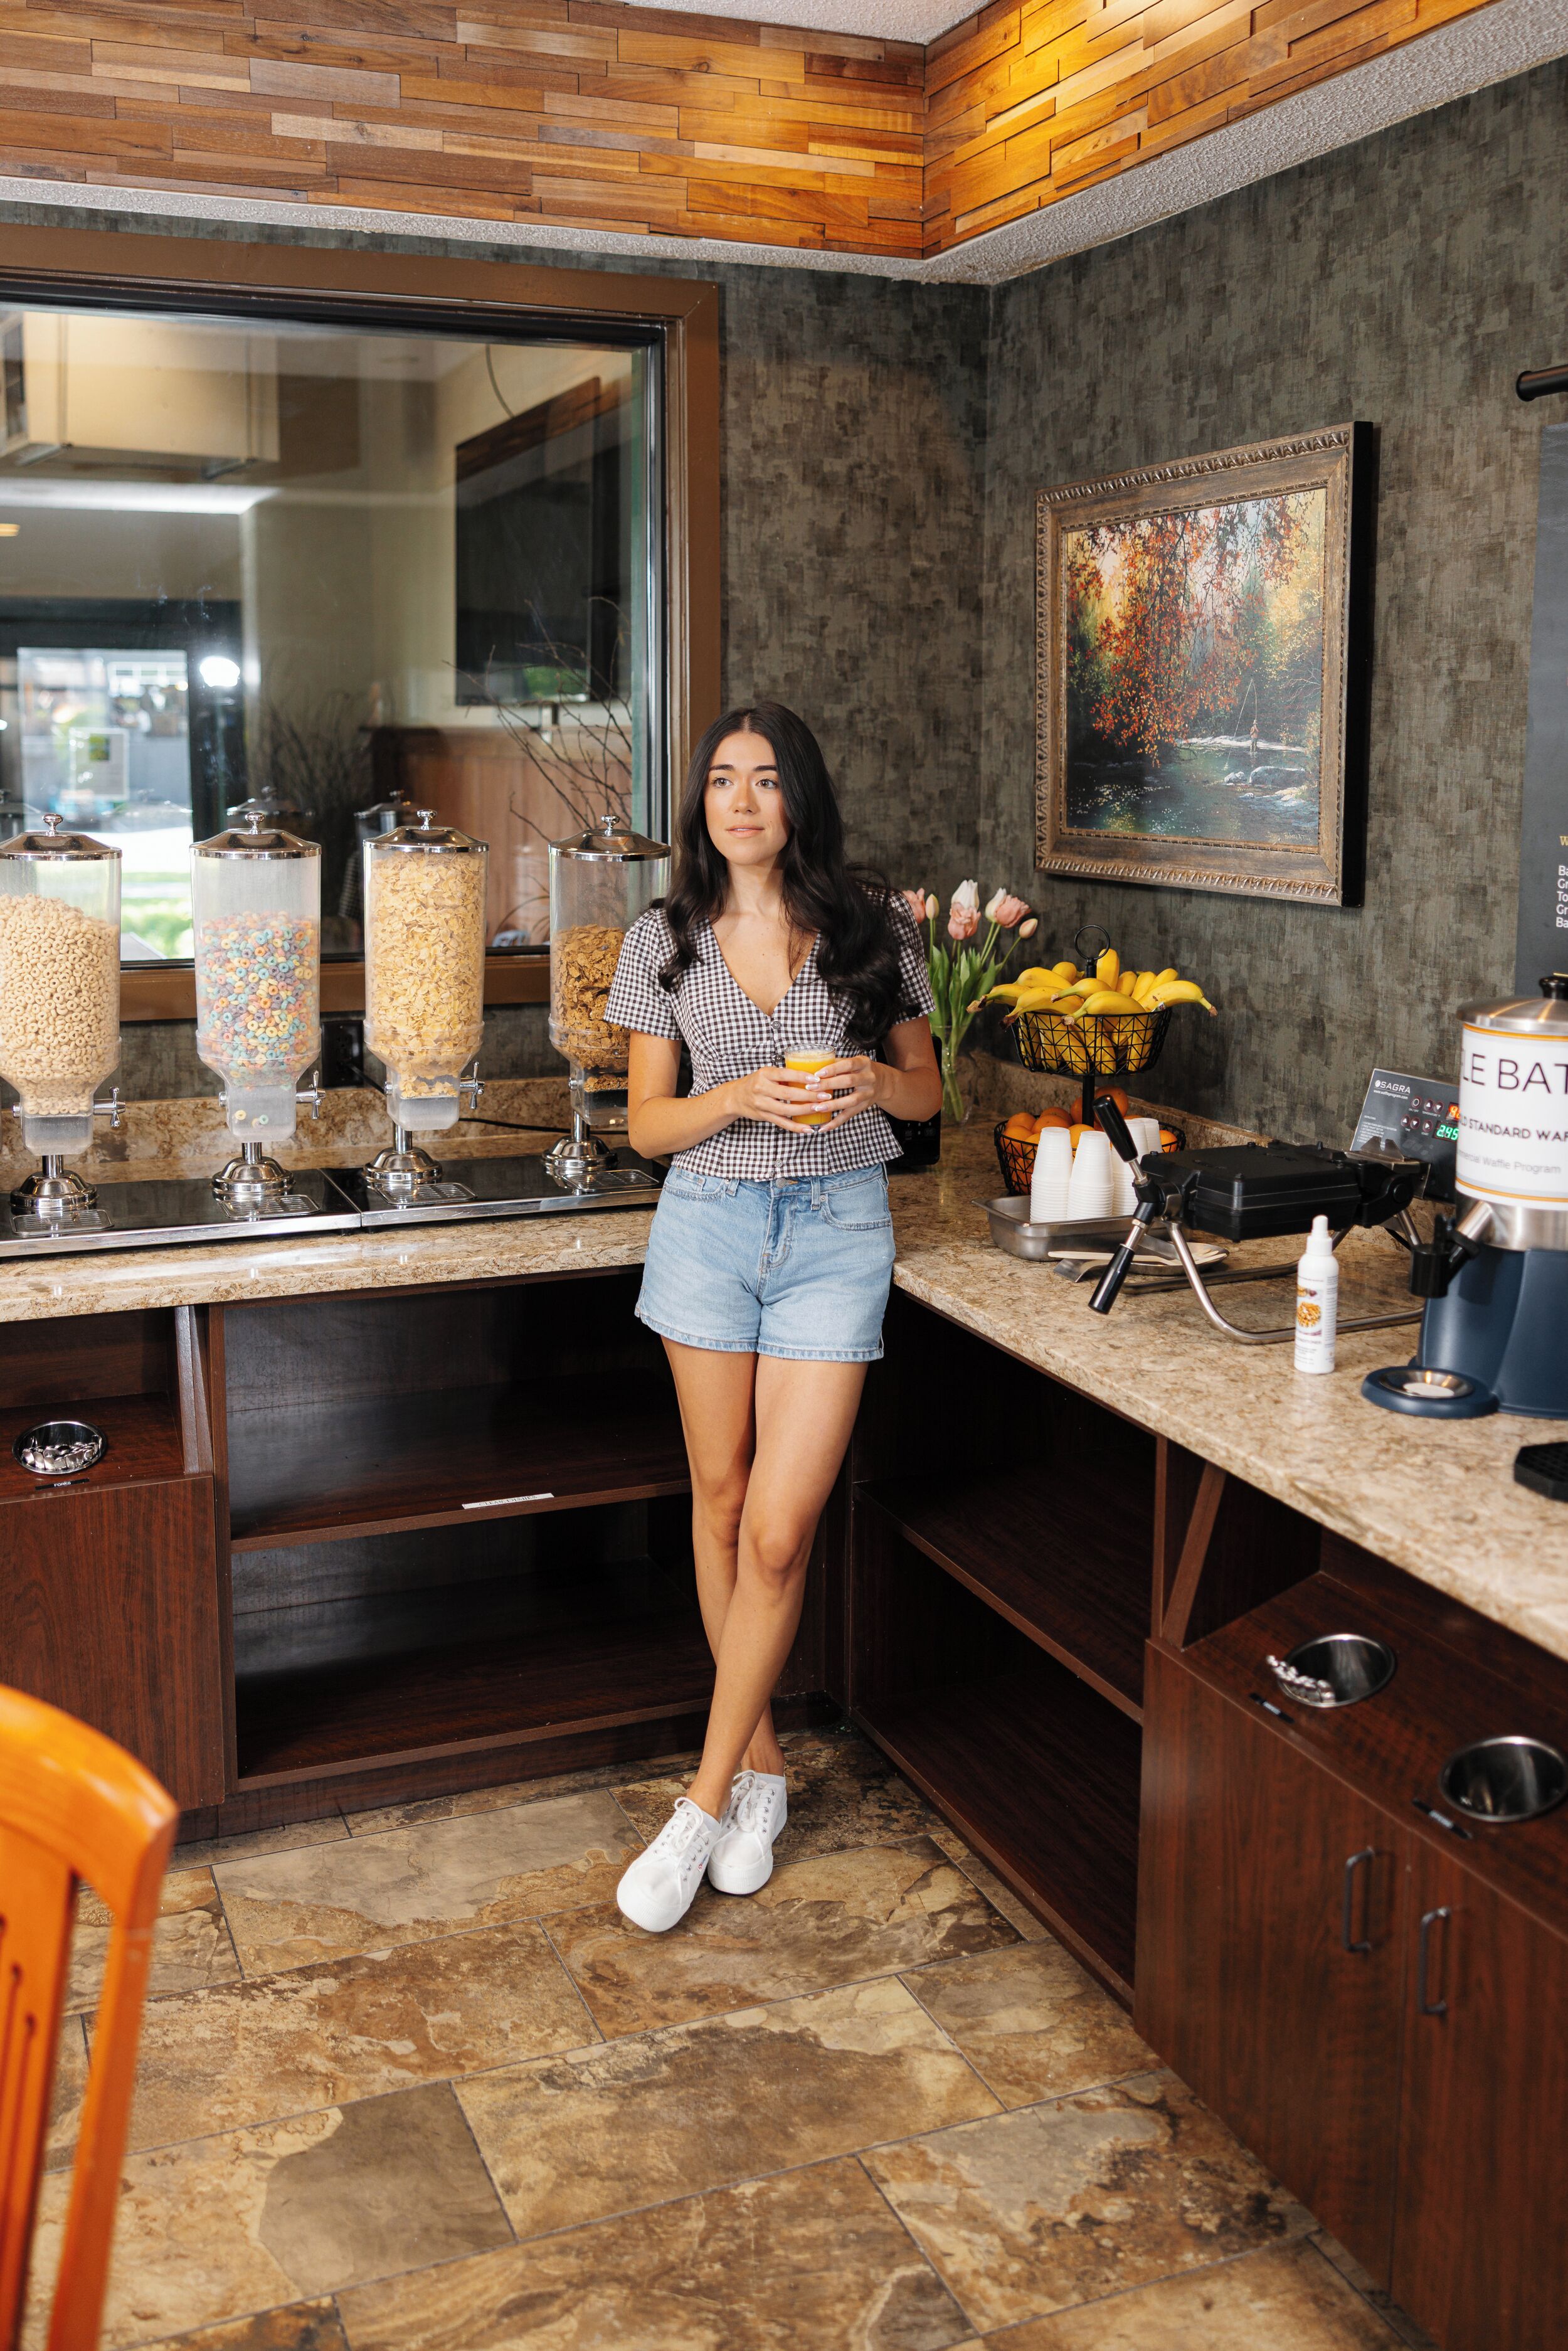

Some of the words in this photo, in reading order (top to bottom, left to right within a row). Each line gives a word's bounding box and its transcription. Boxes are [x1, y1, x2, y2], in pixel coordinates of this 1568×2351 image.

[1462, 1048, 1486, 1086] LE
[1380, 1081, 1411, 1094] SAGRA
[1469, 1118, 1531, 1140] STANDARD
[1483, 1156, 1511, 1169] Waffle
[1513, 1161, 1561, 1175] Program
